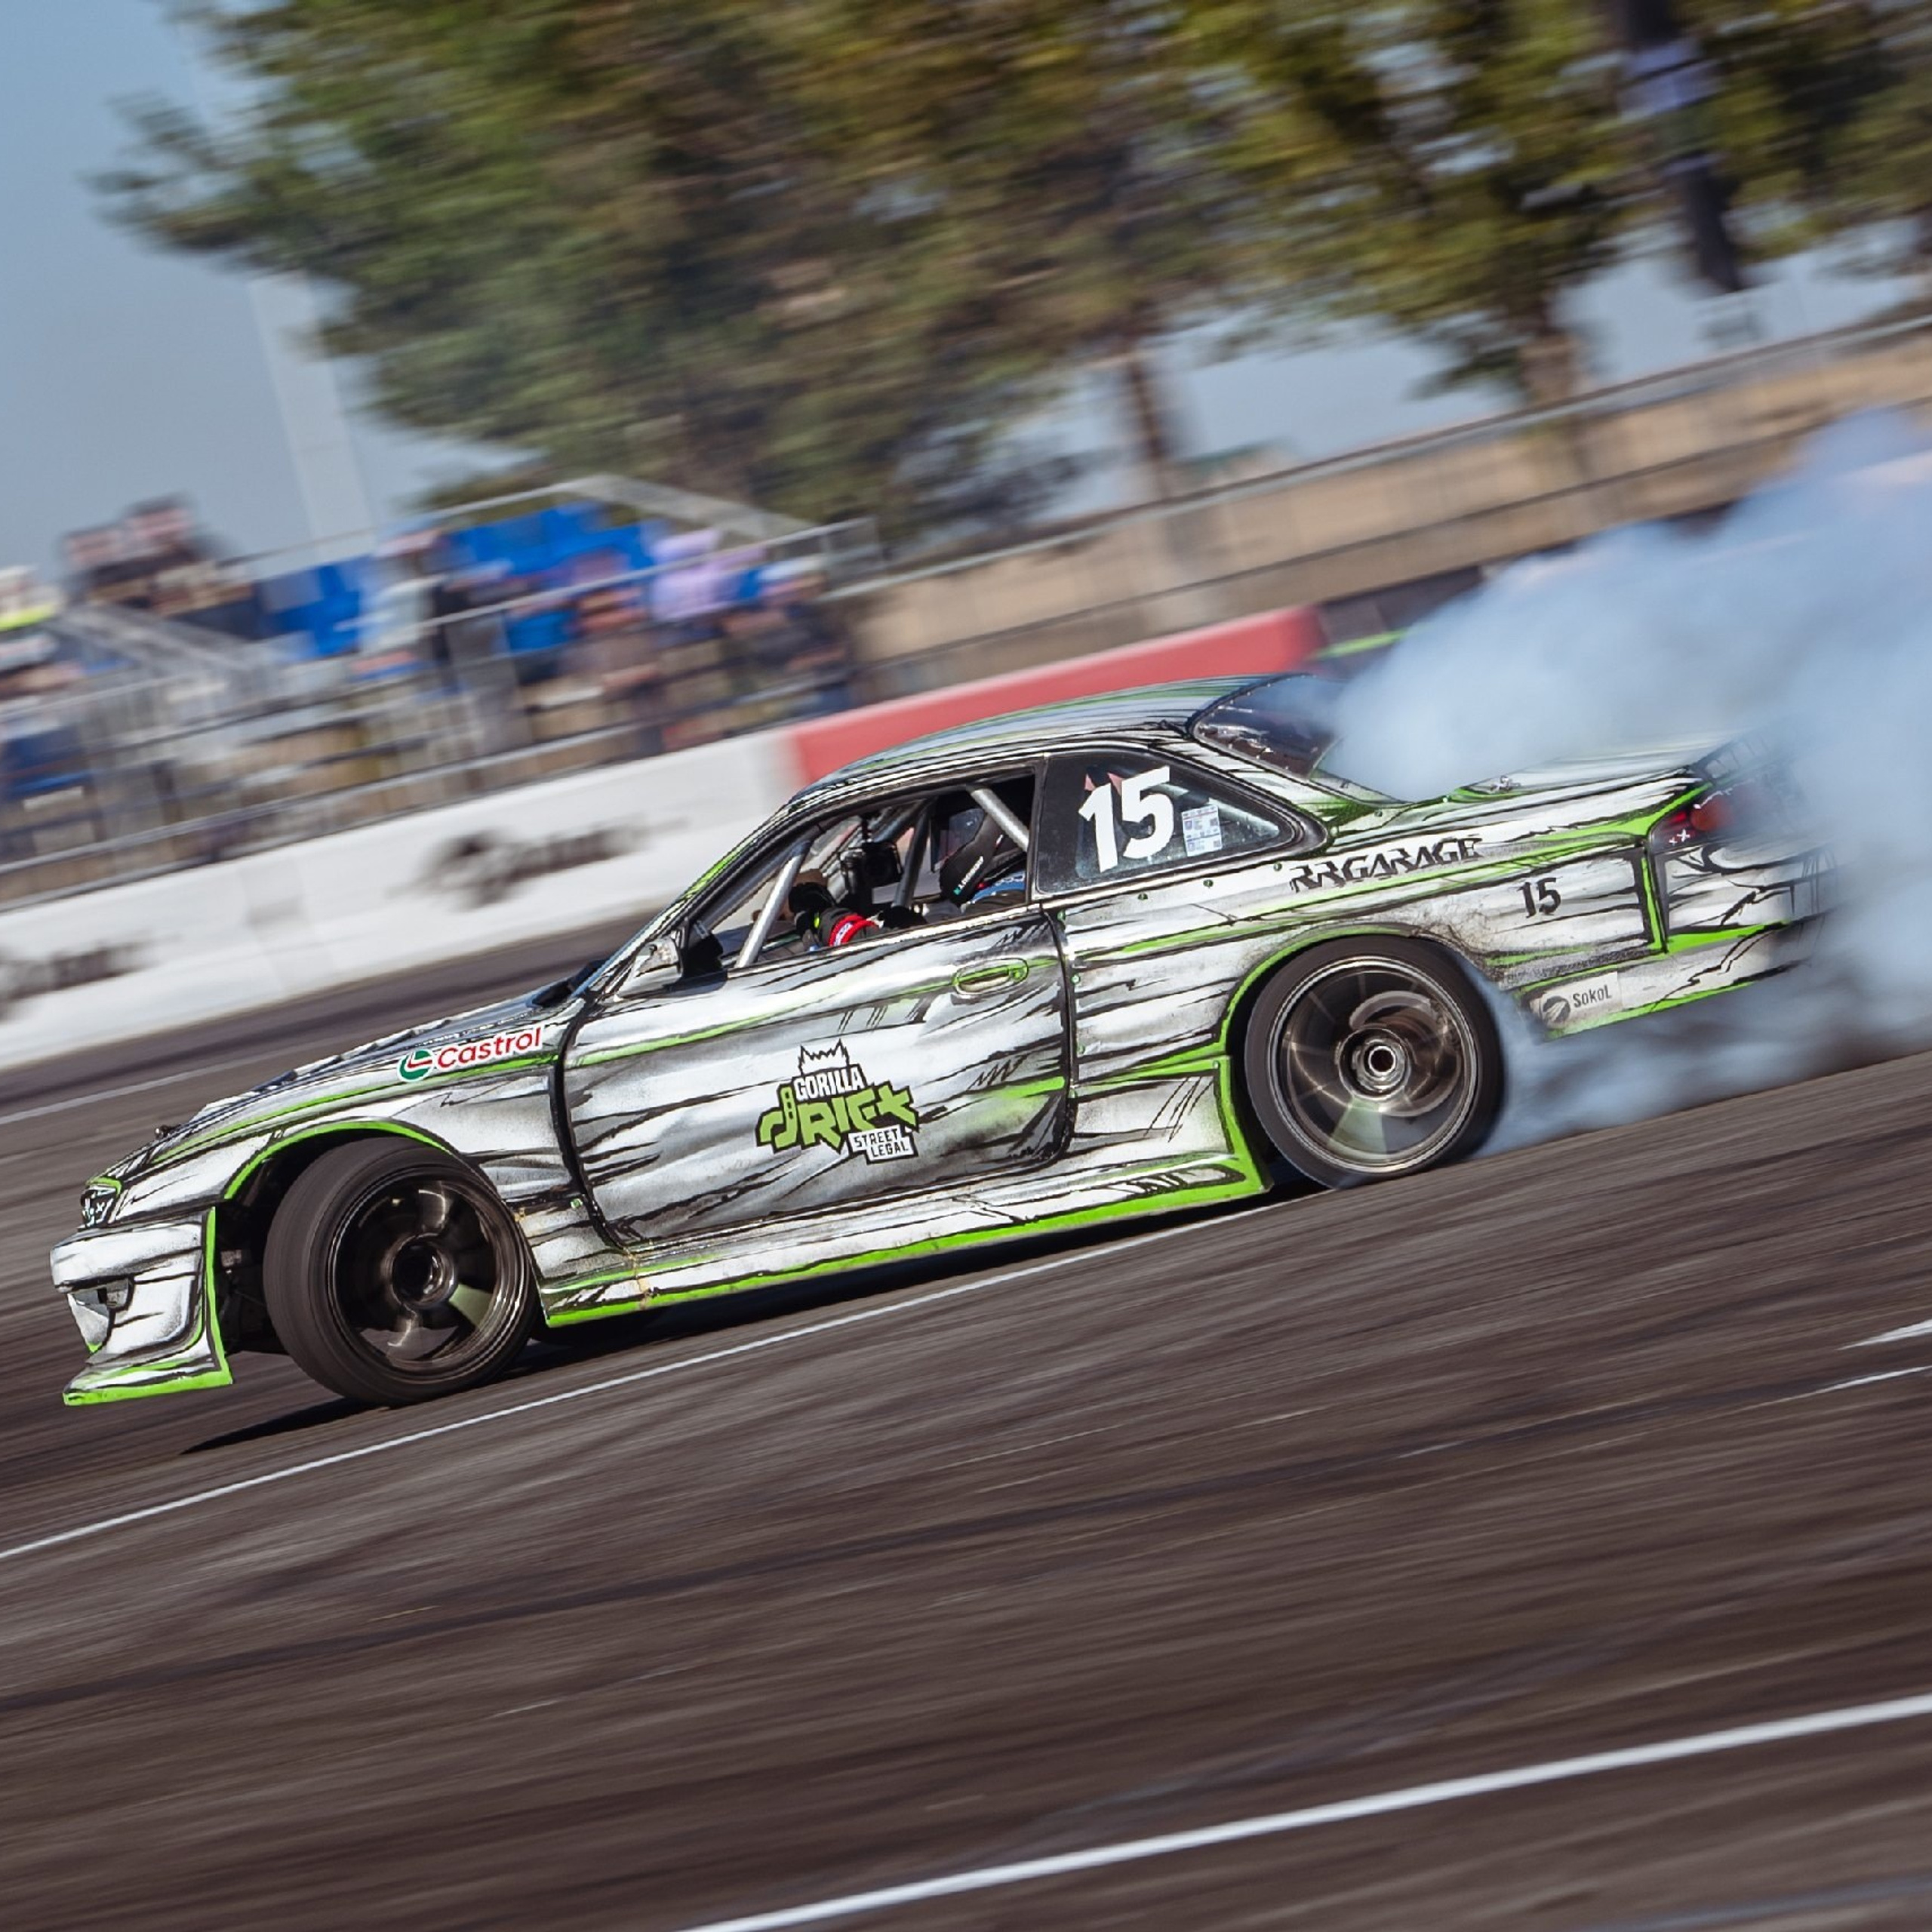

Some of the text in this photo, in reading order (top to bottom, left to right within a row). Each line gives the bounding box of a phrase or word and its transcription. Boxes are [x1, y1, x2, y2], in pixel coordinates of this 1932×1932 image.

[1078, 766, 1174, 872] 15
[1517, 877, 1561, 919] 15
[438, 1027, 541, 1069] Castrol
[794, 1066, 865, 1101] GORILLA
[854, 1128, 899, 1148] STREET
[870, 1140, 909, 1158] LEGAL
